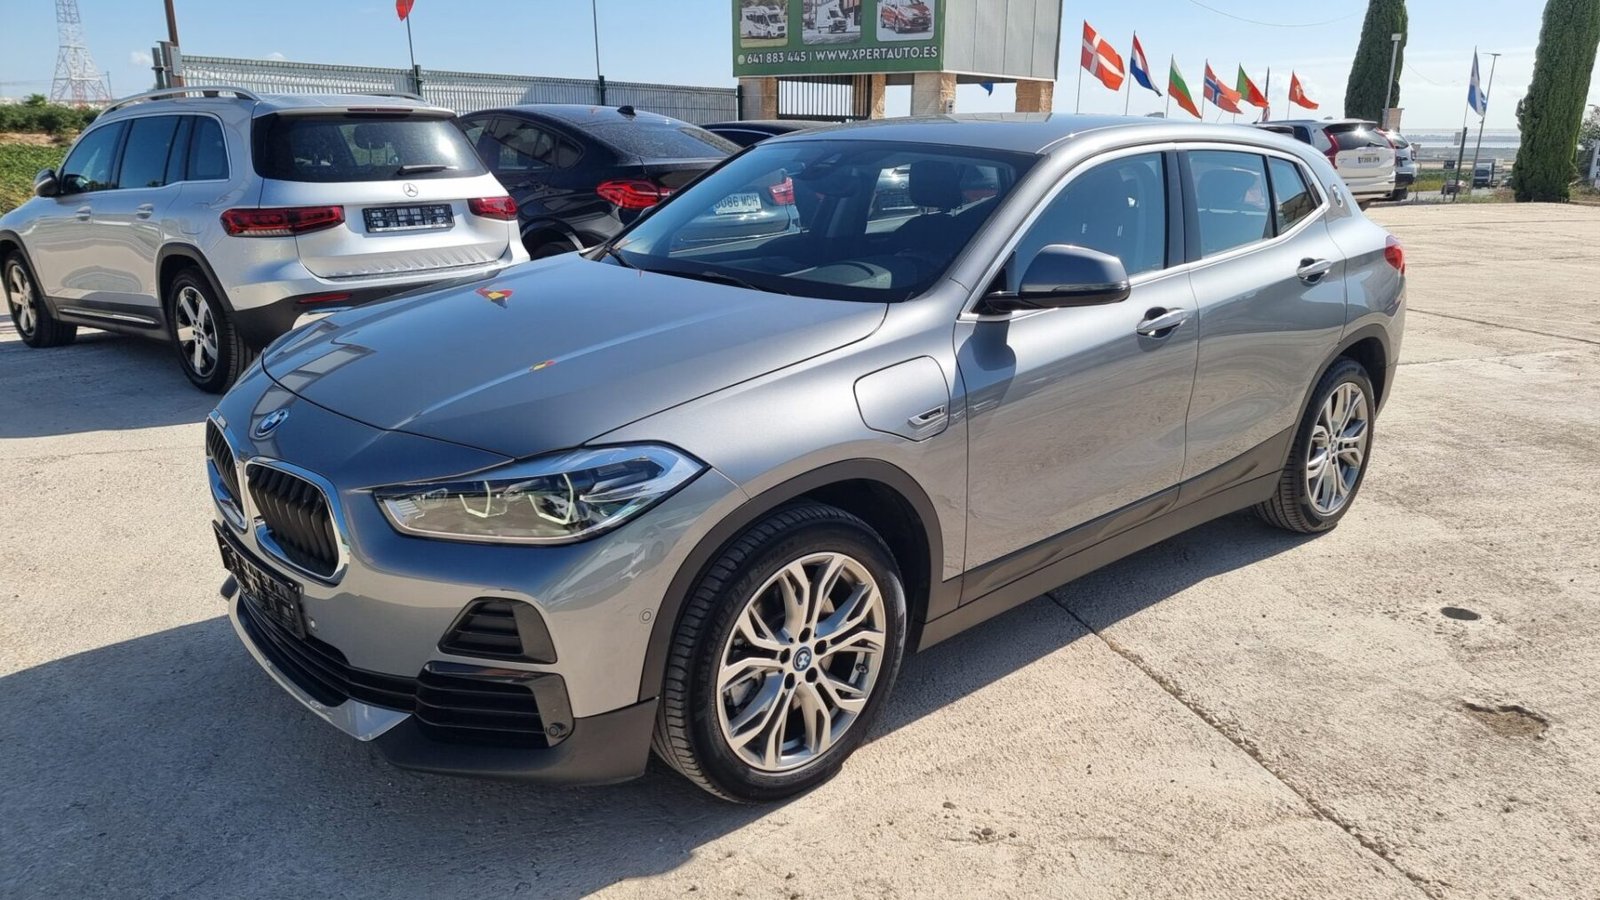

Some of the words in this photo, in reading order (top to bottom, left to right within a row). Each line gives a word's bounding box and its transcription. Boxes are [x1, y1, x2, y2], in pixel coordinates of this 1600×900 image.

[747, 53, 763, 64] 641
[766, 52, 784, 64] 883
[787, 51, 807, 63] 445
[815, 46, 938, 61] WWW.XPERTAUTO.ES
